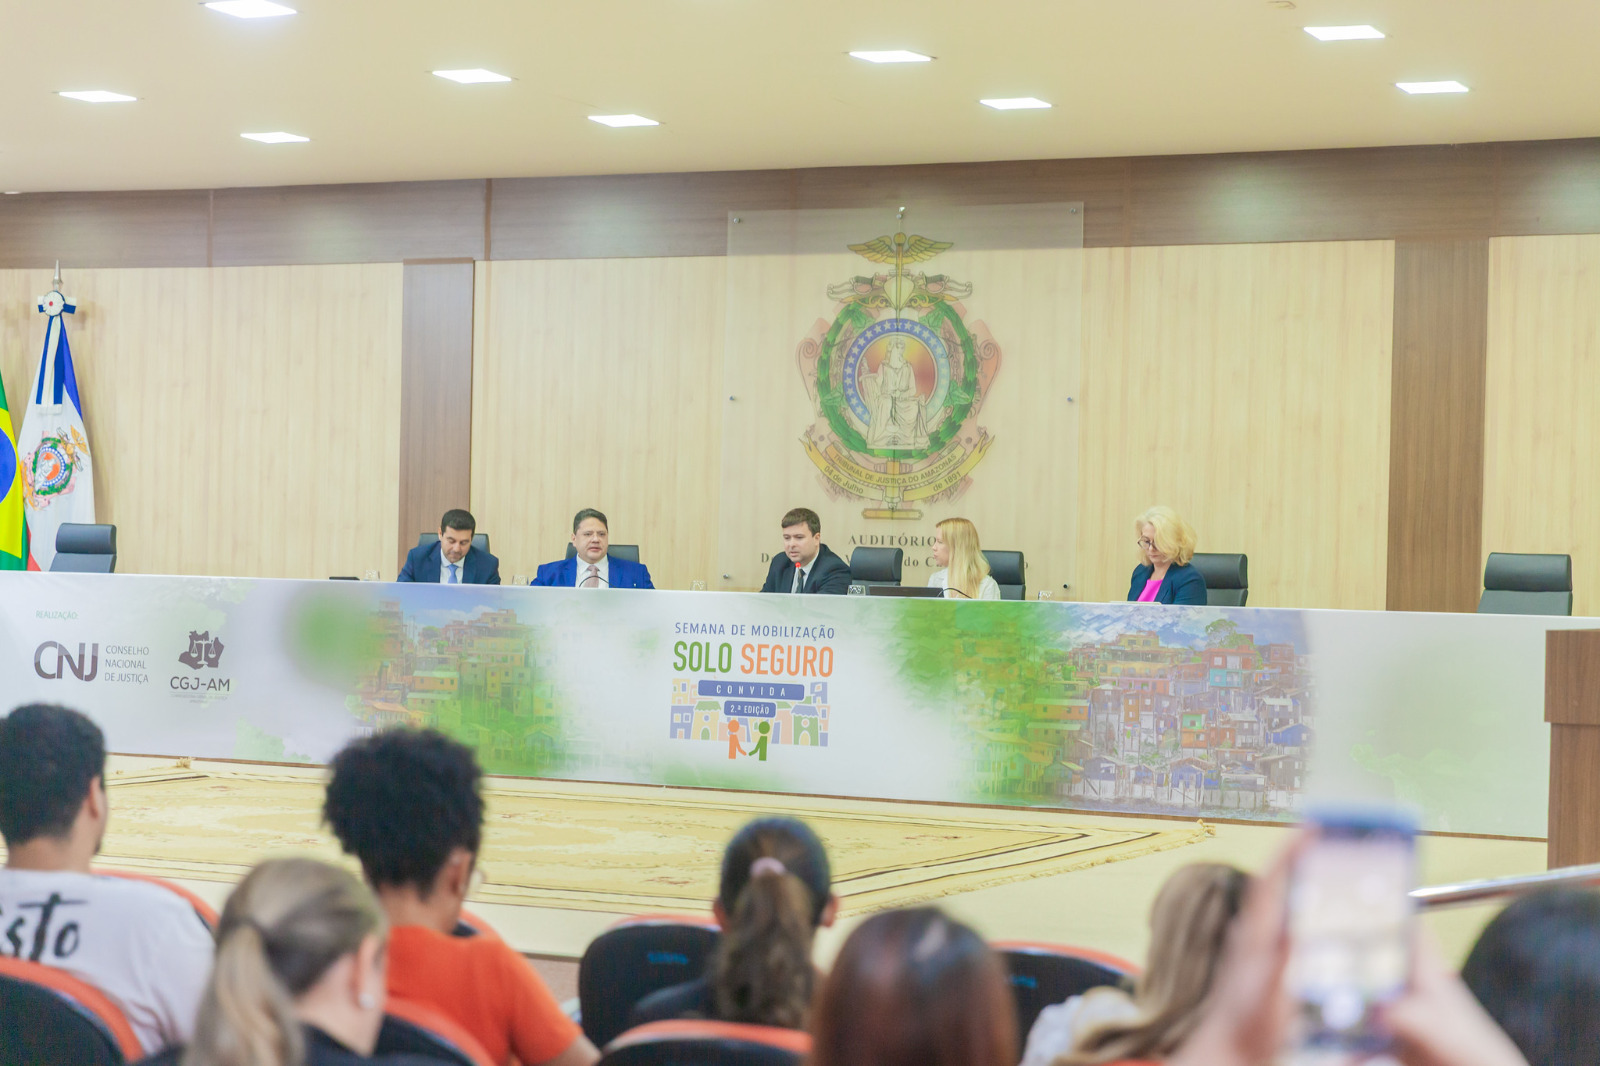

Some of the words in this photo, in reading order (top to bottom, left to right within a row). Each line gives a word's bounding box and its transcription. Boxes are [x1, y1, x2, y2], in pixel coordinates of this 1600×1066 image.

[833, 453, 863, 477] TRIBUNAL
[865, 473, 874, 481] DE
[908, 474, 919, 483] DO
[920, 454, 957, 480] AMAZONAS
[842, 480, 864, 494] Julho
[848, 532, 937, 547] AUDITÓRIO
[675, 622, 726, 636] SEMANA
[731, 624, 746, 636] DE
[751, 624, 835, 642] MOBILIZAÇÃO
[105, 645, 150, 656] CONSELHO
[34, 641, 99, 682] CNJ
[104, 659, 147, 670] NACIONAL
[673, 640, 732, 673] SOLO
[740, 643, 834, 678] SEGURO
[104, 673, 115, 682] DE
[116, 673, 149, 685] JUSTIÇA
[170, 676, 230, 692] CGJ-AM
[716, 684, 786, 697] CONVIDA
[743, 704, 770, 716] EDIÇÃO
